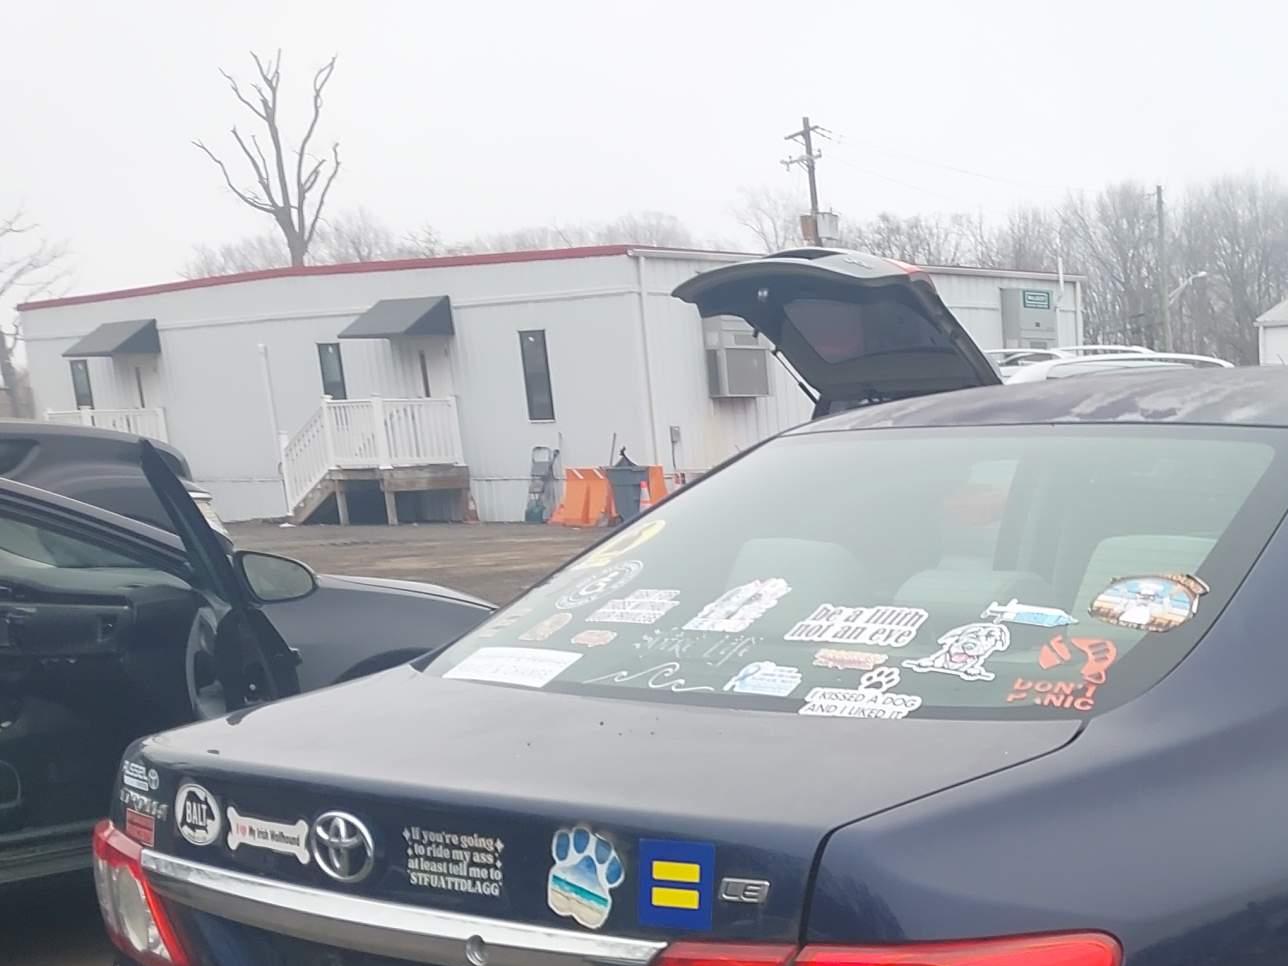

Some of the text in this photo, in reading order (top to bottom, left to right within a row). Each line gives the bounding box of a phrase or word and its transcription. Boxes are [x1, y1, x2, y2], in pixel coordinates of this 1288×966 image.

[790, 623, 913, 643] not an eve
[807, 703, 837, 713] AND
[882, 696, 918, 708] DOG
[186, 800, 207, 827] BALT
[411, 826, 495, 852] If you're going
[414, 843, 494, 865] to ride my ass
[408, 858, 502, 881] at least tell me to
